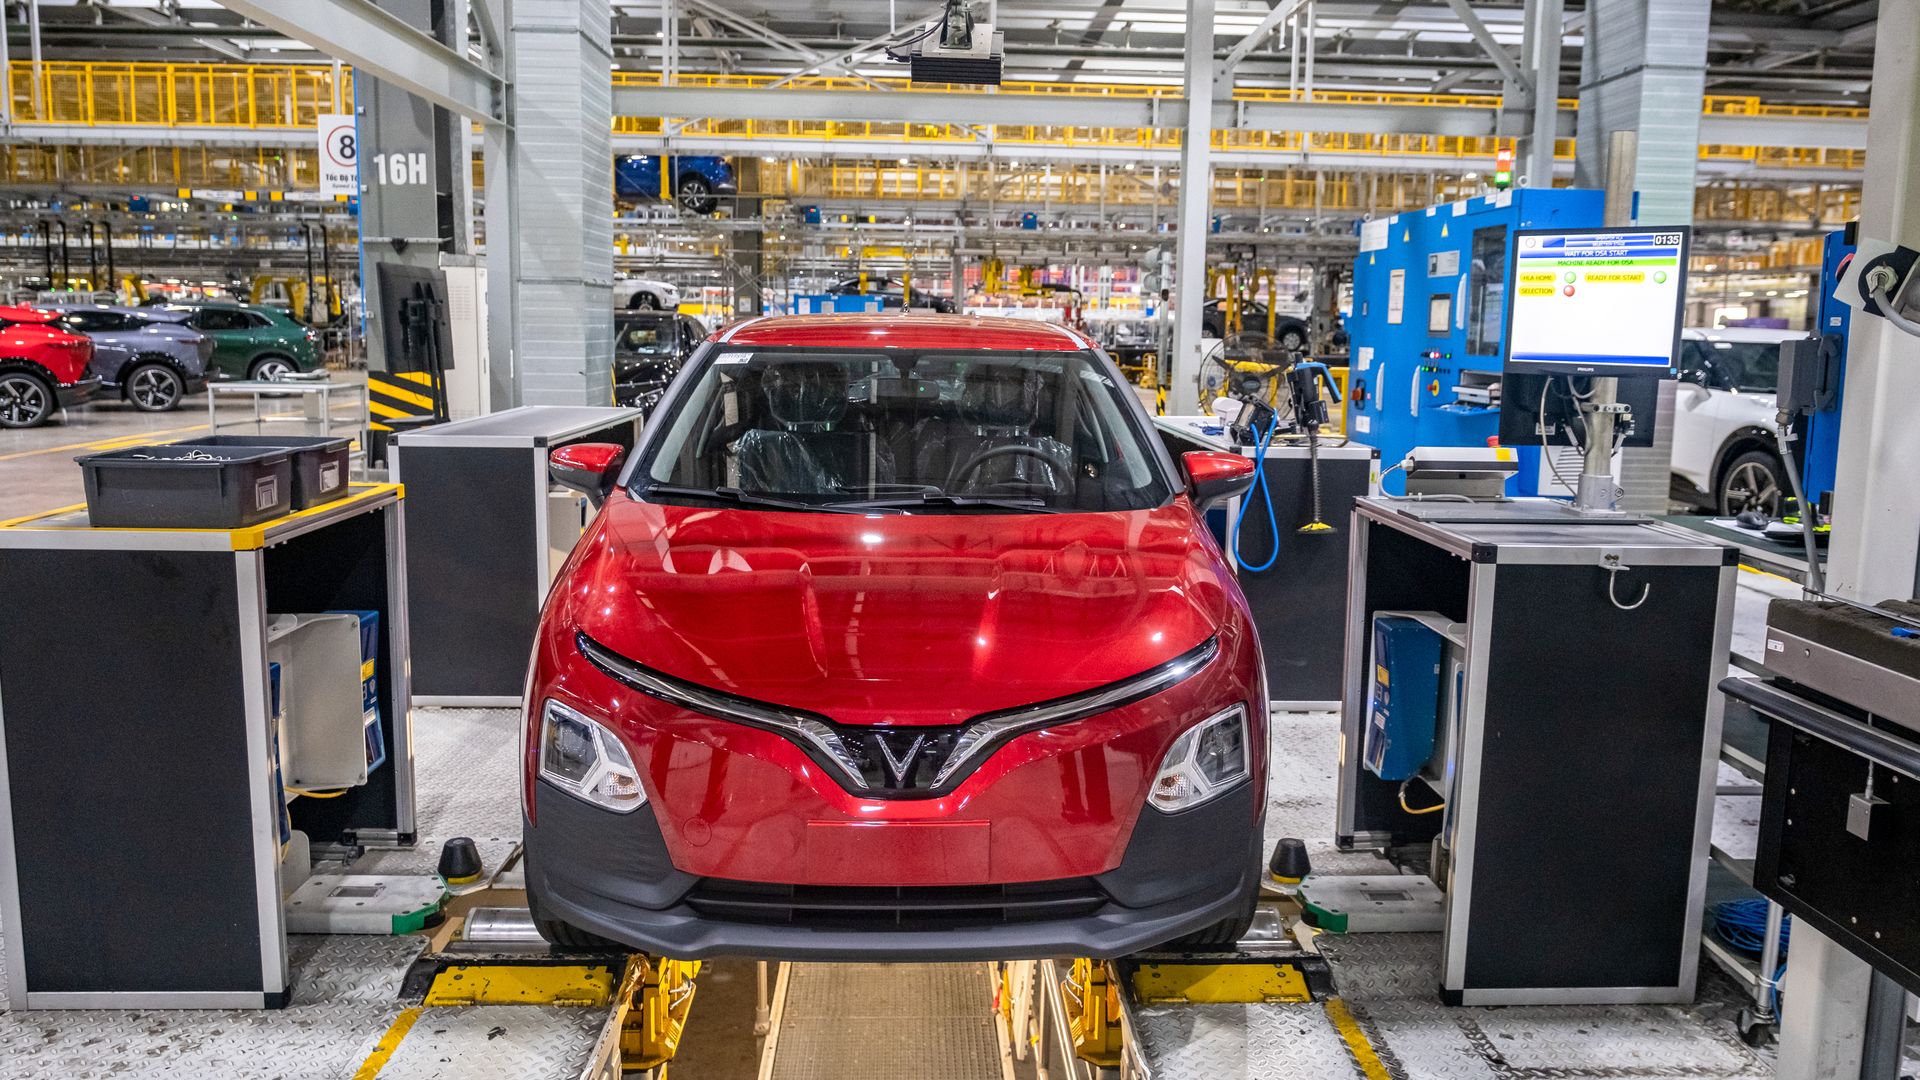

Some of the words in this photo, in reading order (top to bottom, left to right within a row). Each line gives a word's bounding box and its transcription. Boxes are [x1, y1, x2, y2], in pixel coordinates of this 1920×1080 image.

[340, 135, 356, 159] 8
[373, 153, 427, 185] 16H
[1655, 235, 1679, 245] 0135
[1564, 249, 1580, 257] WAIT
[1581, 249, 1594, 257] FOR
[1595, 249, 1608, 257] DSA
